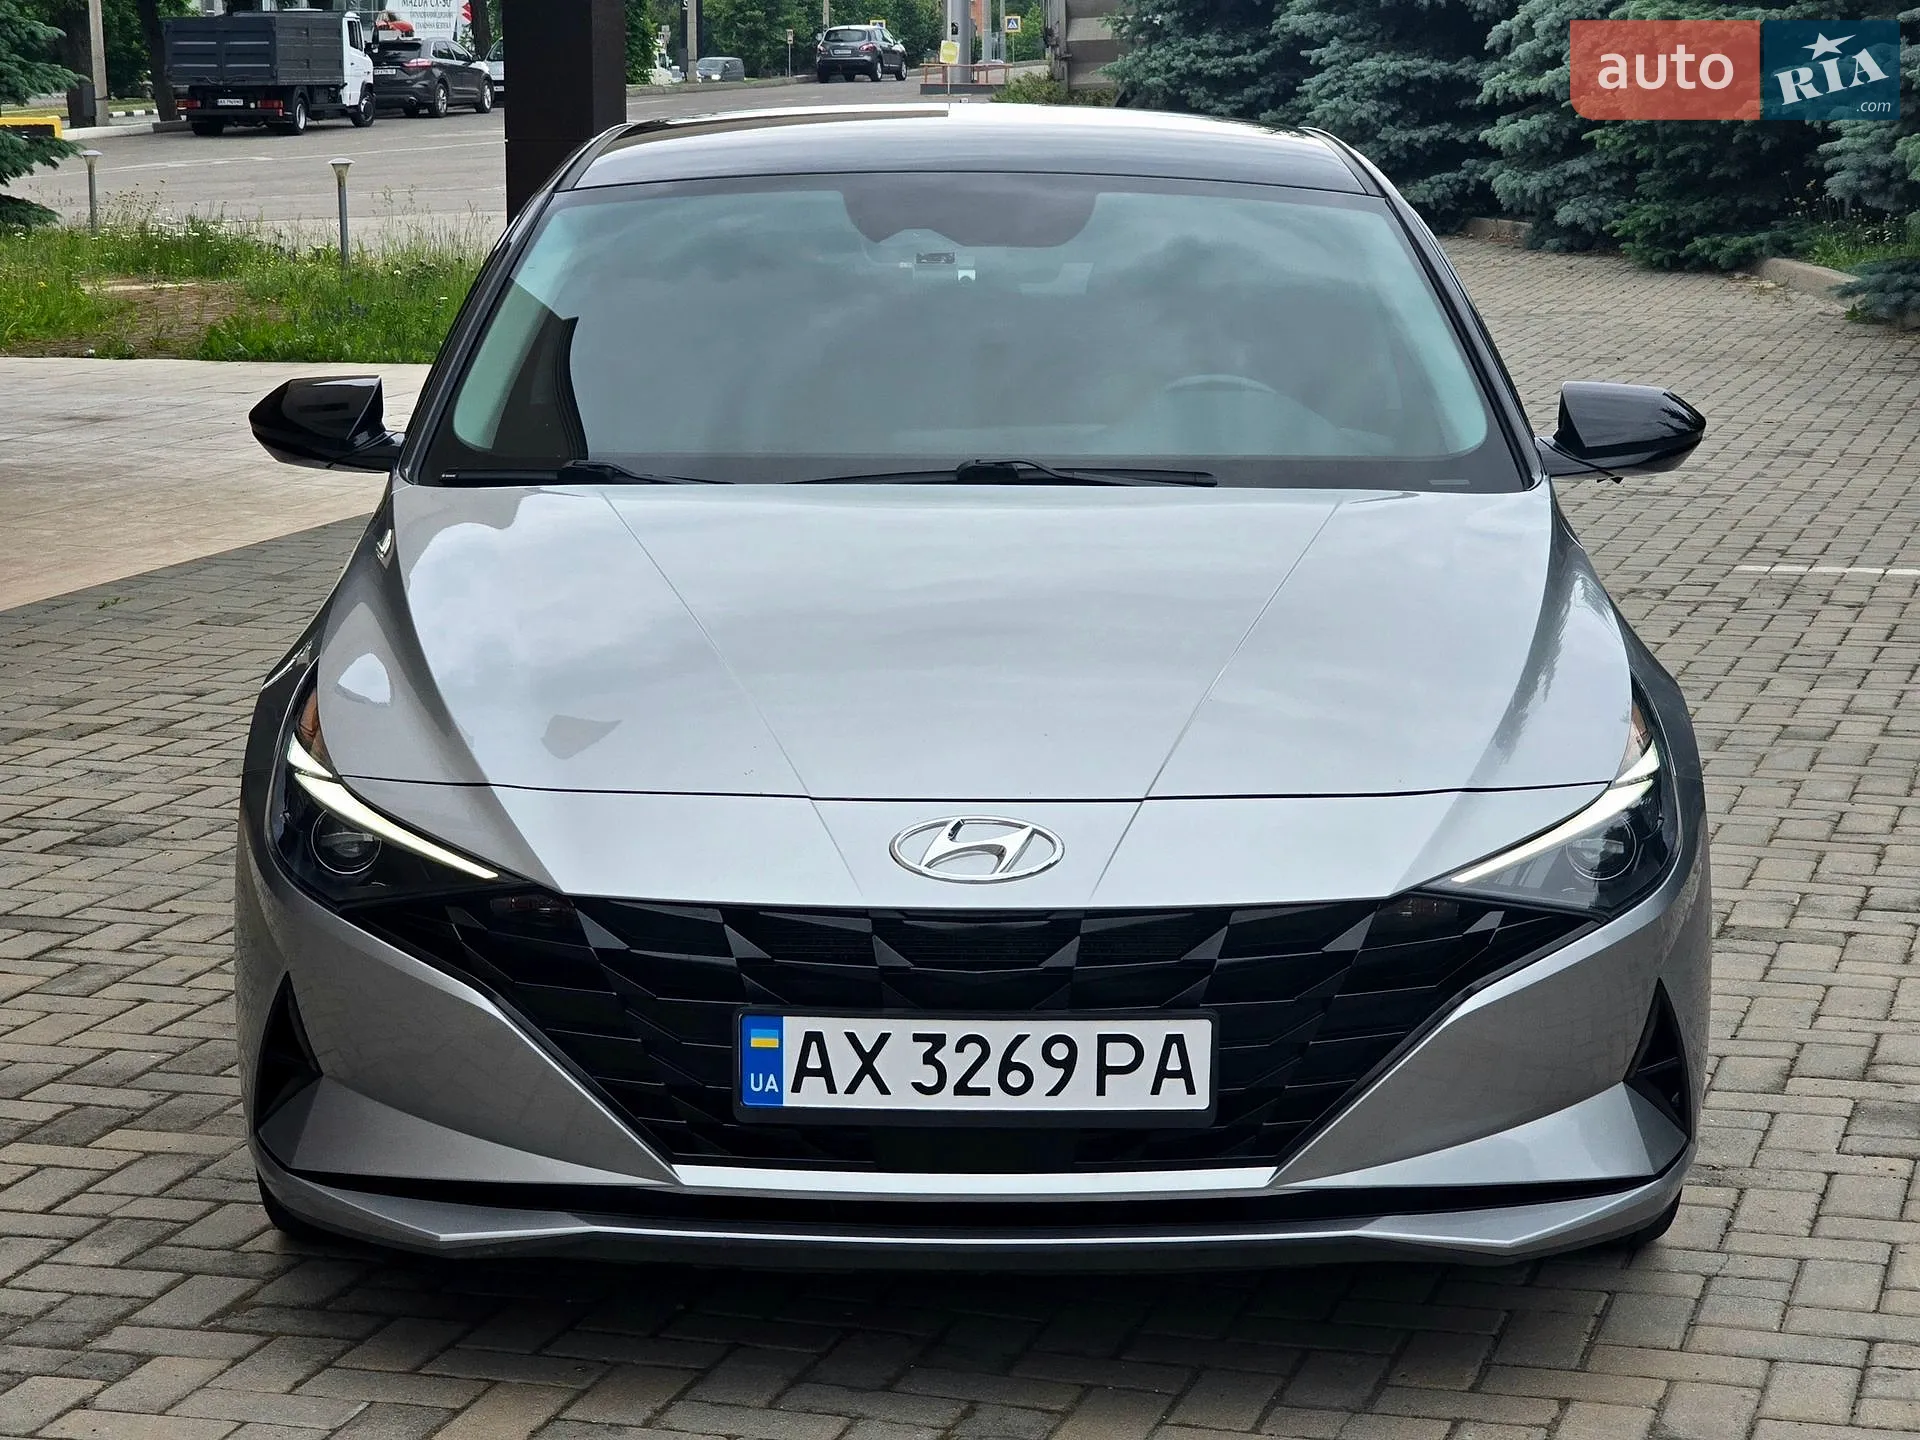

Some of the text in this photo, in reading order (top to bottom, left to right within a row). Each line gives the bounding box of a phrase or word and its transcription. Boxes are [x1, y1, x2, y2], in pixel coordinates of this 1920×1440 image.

[750, 1073, 779, 1093] UA
[790, 1031, 1197, 1097] AX 3269 PA
